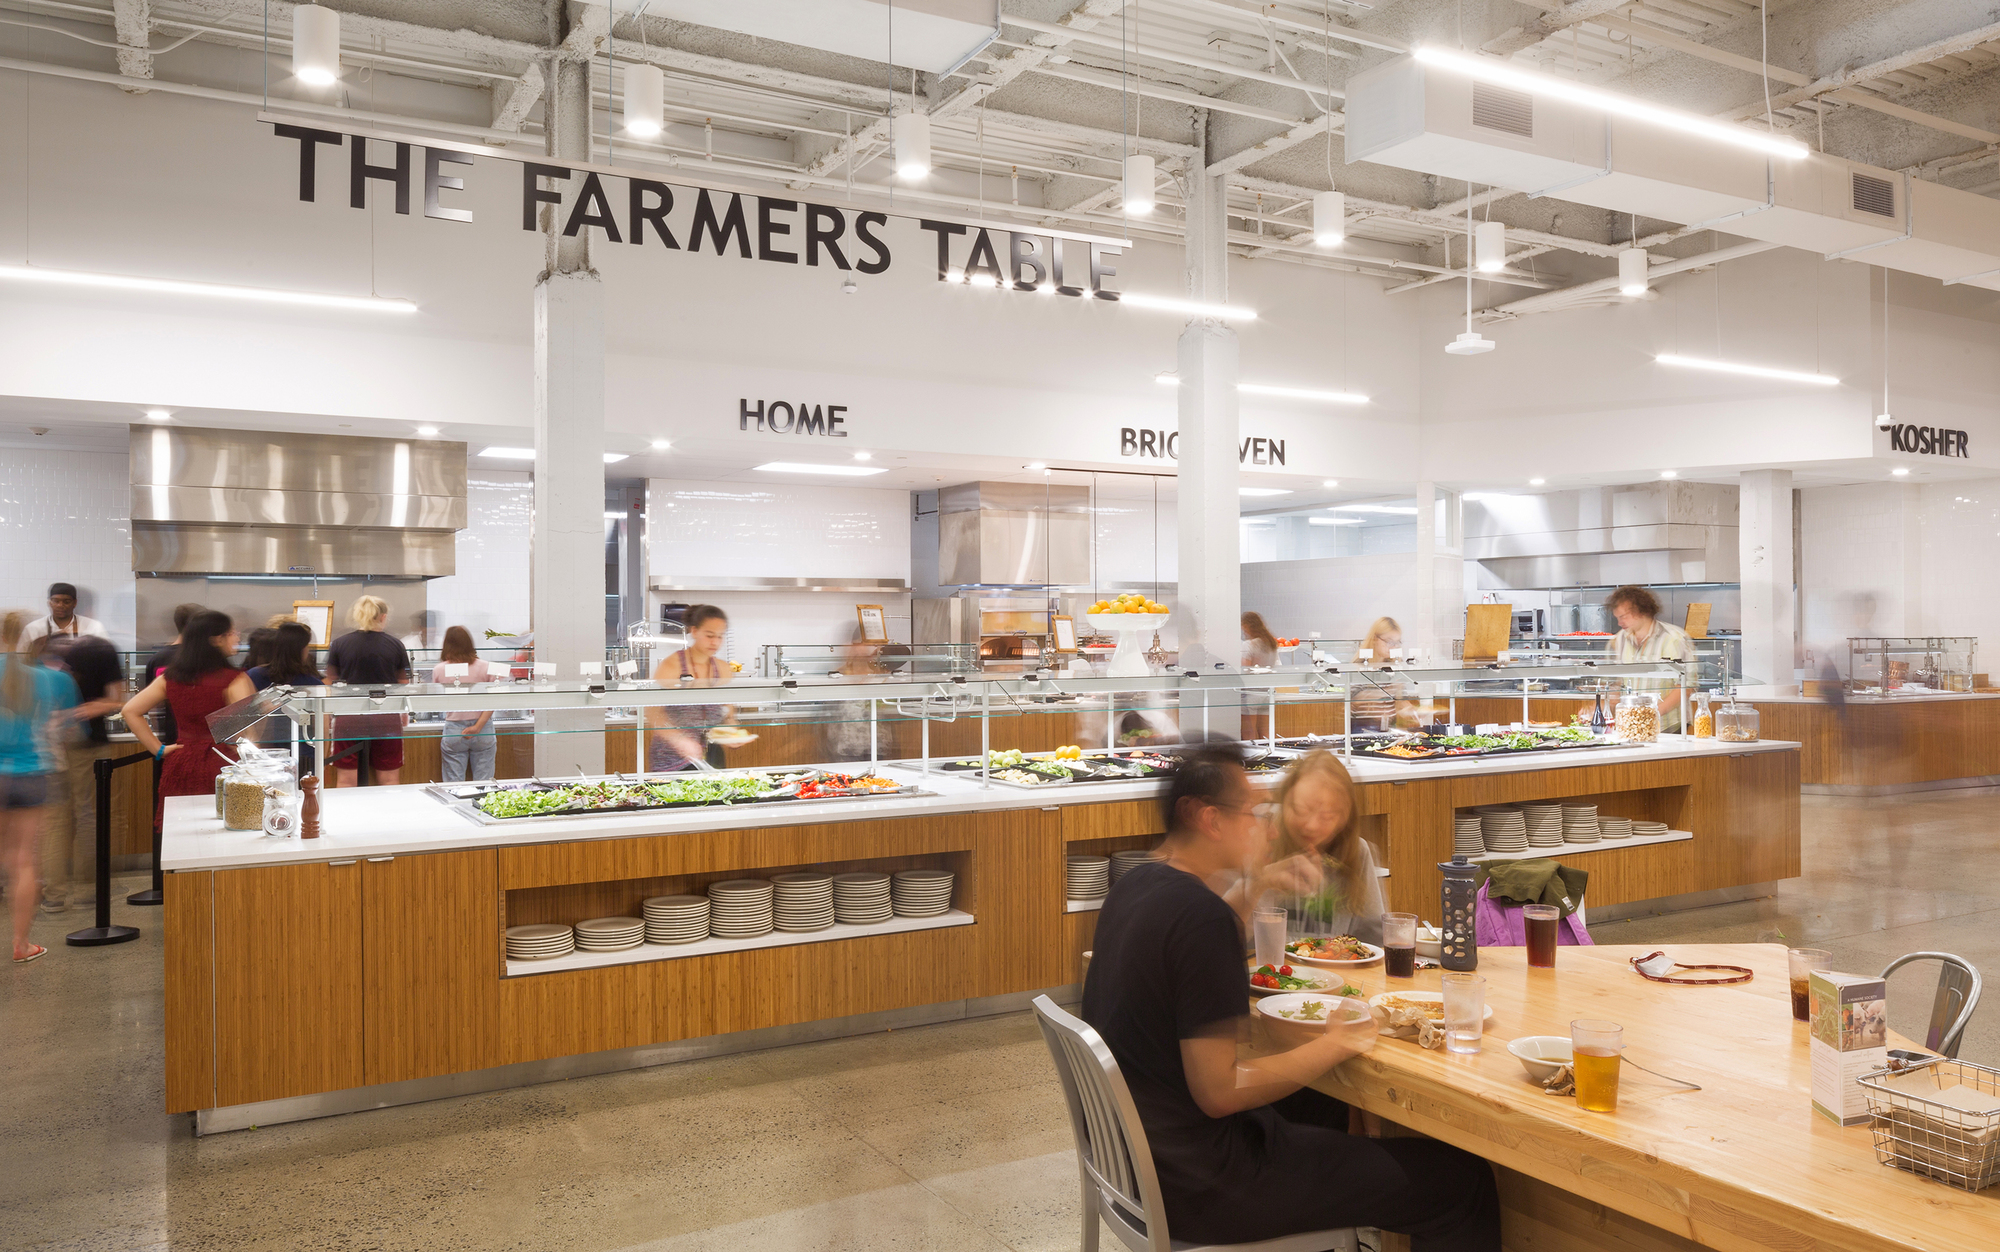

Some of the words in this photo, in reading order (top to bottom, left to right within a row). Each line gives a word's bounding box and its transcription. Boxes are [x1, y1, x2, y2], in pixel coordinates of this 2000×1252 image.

[274, 123, 474, 224] THE
[523, 161, 891, 275] FARMERS
[920, 218, 1123, 301] TABLE
[740, 398, 848, 438] HOME
[1121, 427, 1179, 460] BRIC
[1238, 436, 1286, 466] VEN
[1891, 423, 1970, 459] KOSHER
